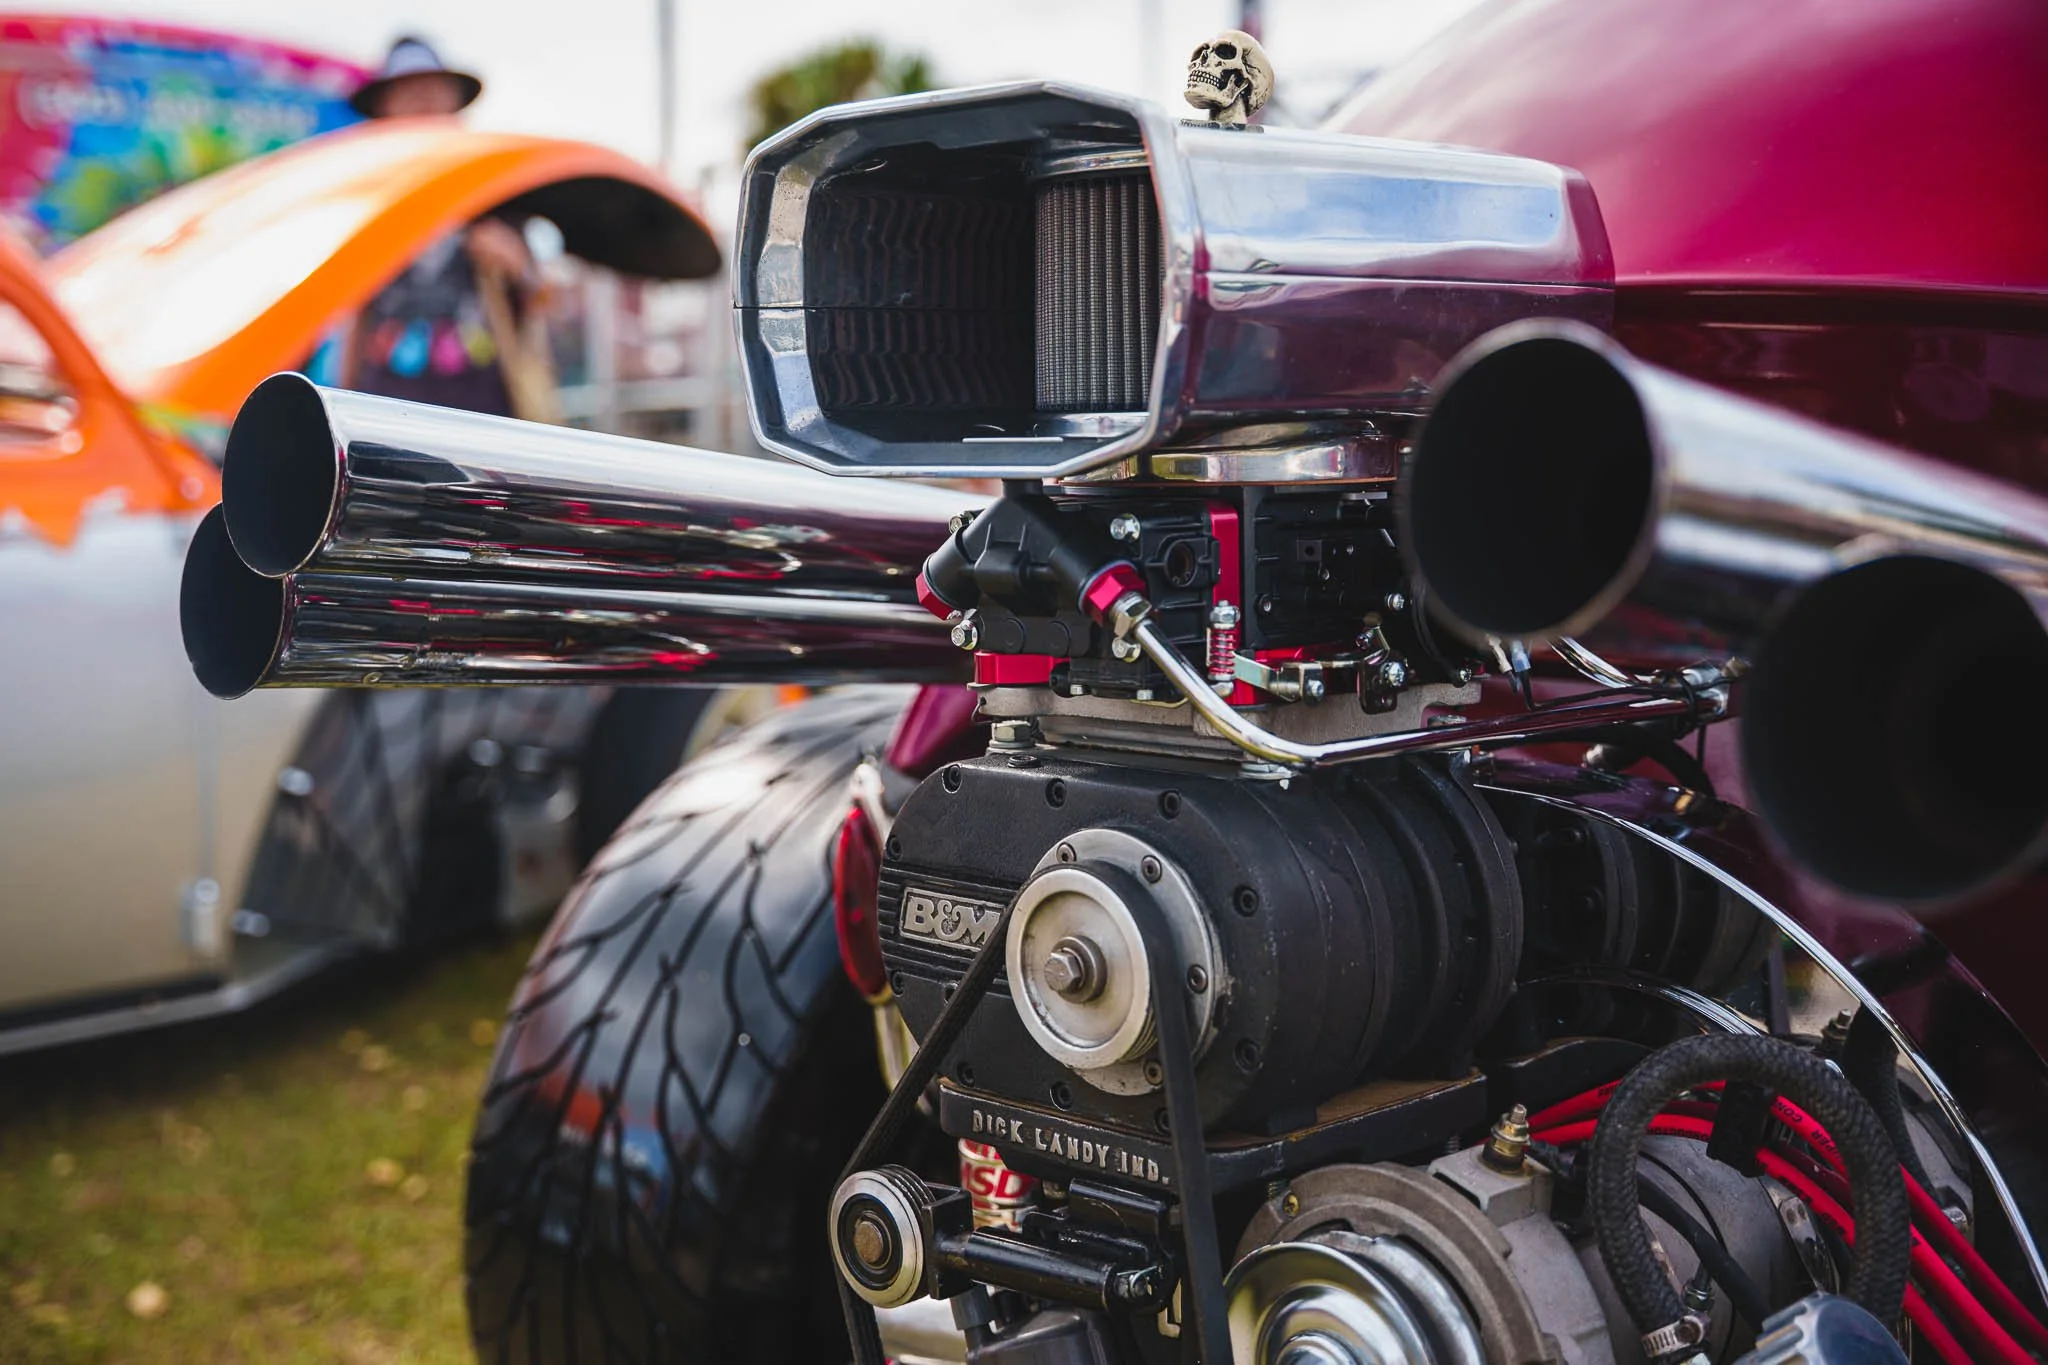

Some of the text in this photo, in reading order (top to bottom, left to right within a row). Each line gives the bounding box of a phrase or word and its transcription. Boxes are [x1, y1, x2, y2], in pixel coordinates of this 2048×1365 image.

[903, 895, 1001, 945] B&M
[972, 1109, 1025, 1144] DICK
[1034, 1127, 1110, 1168] LANDY
